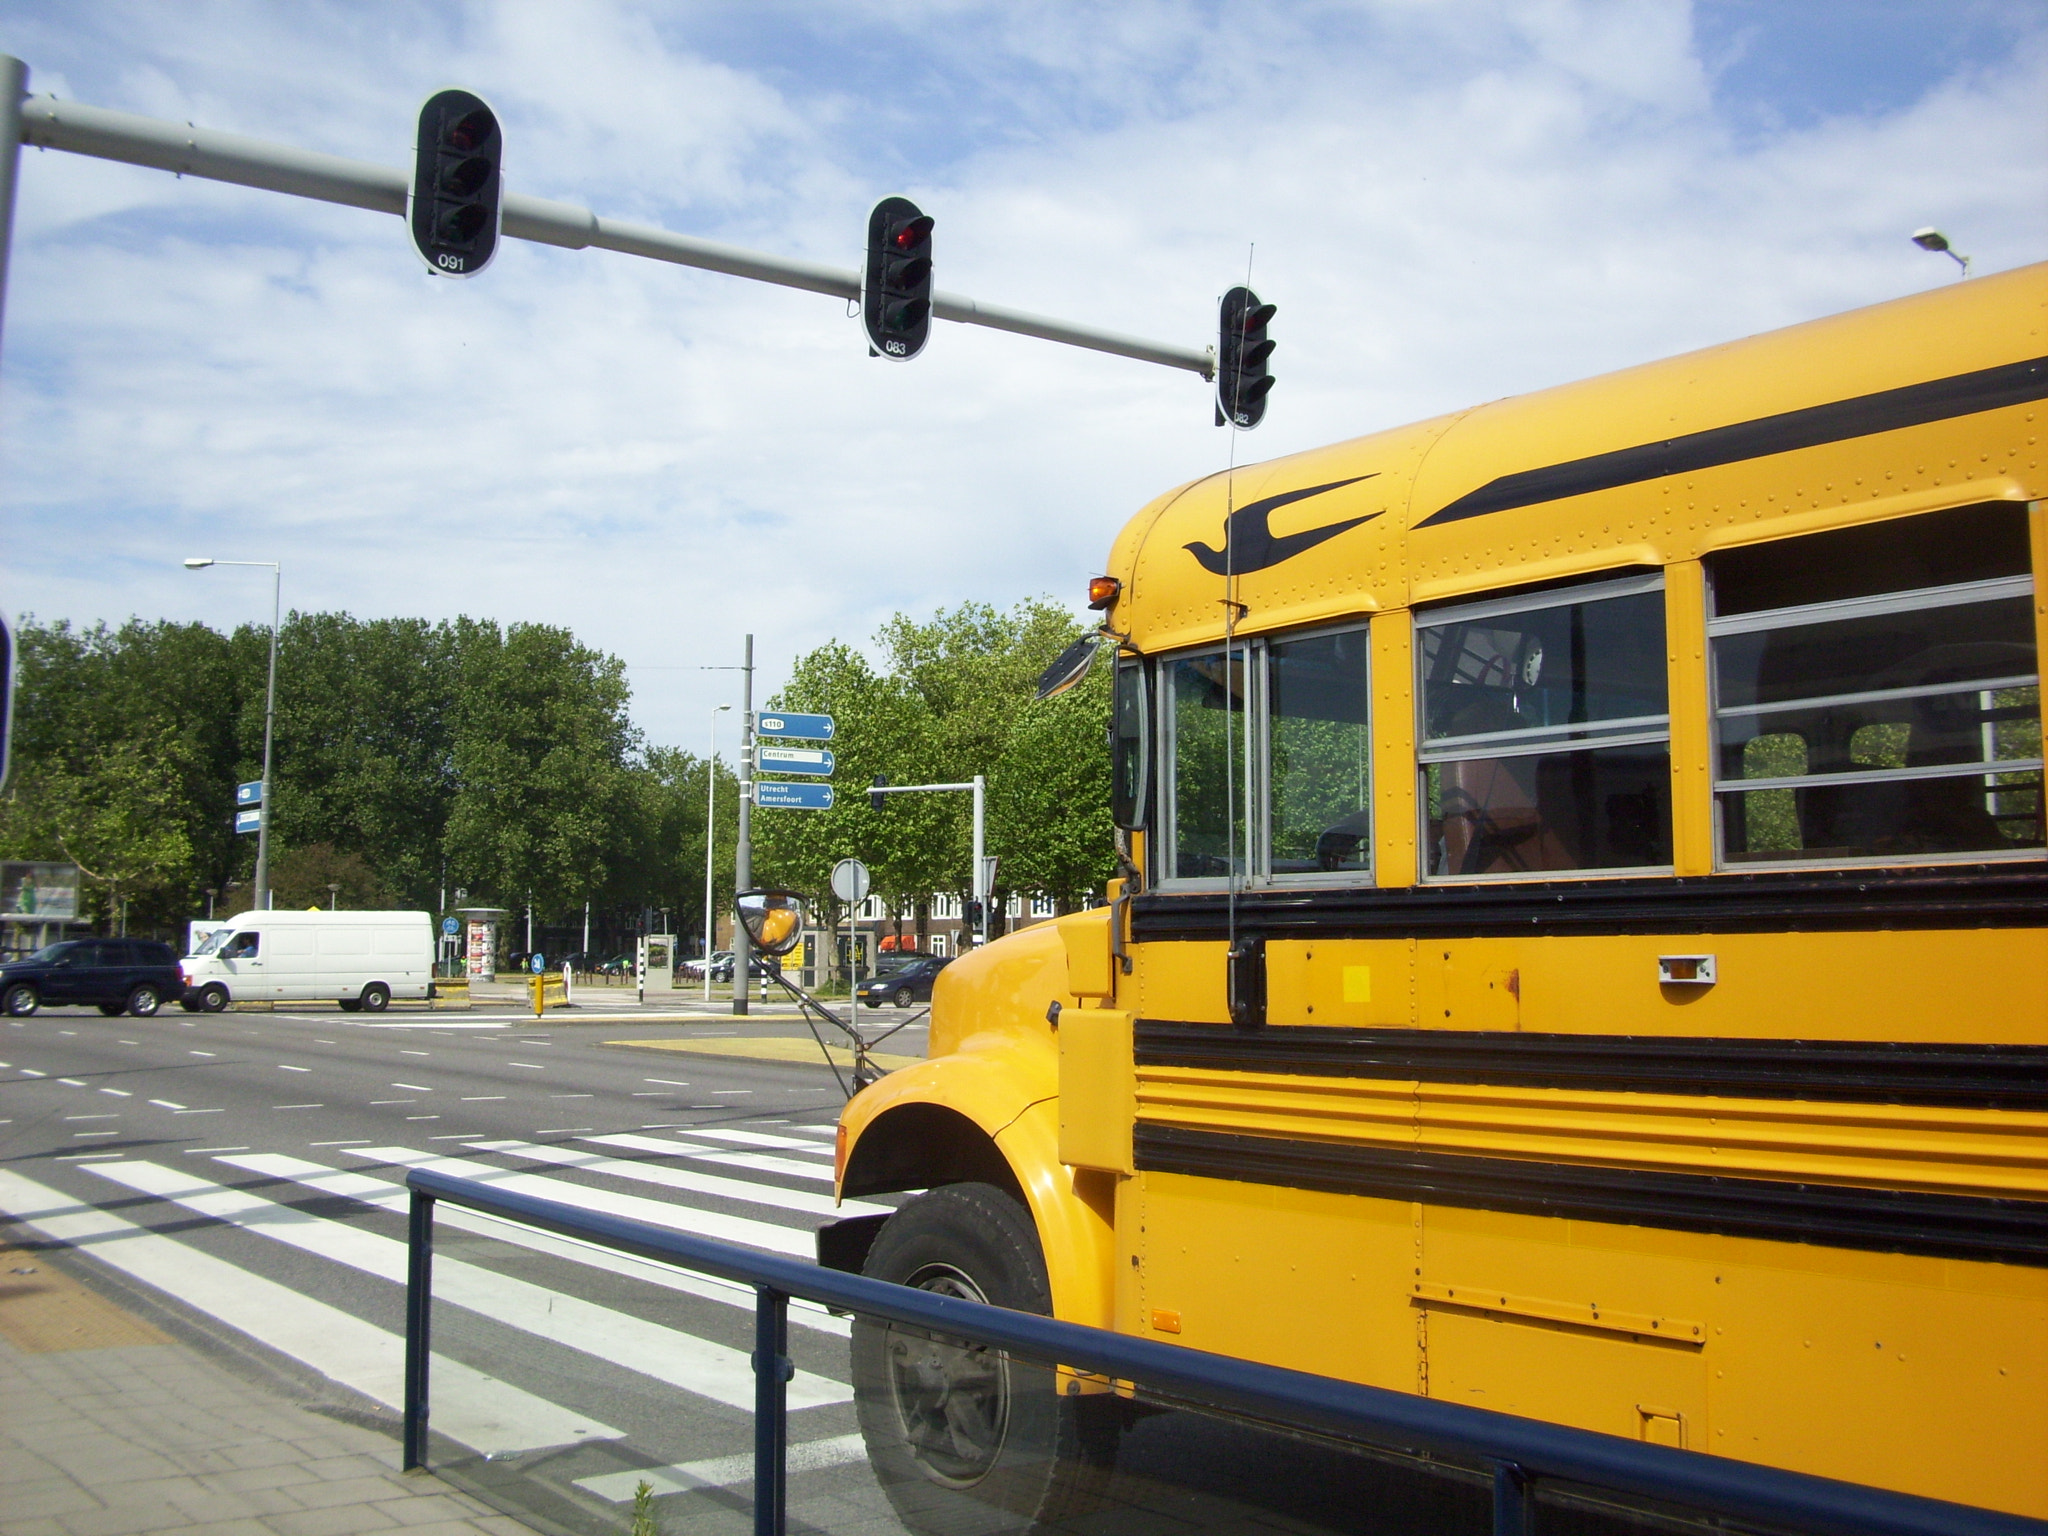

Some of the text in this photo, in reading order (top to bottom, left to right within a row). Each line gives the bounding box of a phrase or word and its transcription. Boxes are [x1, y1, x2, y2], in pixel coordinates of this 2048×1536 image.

[438, 254, 464, 271] 091
[886, 340, 906, 355] 083
[763, 750, 794, 759] Centrum
[760, 785, 789, 793] Utrecht
[760, 794, 802, 803] Amersfoort
